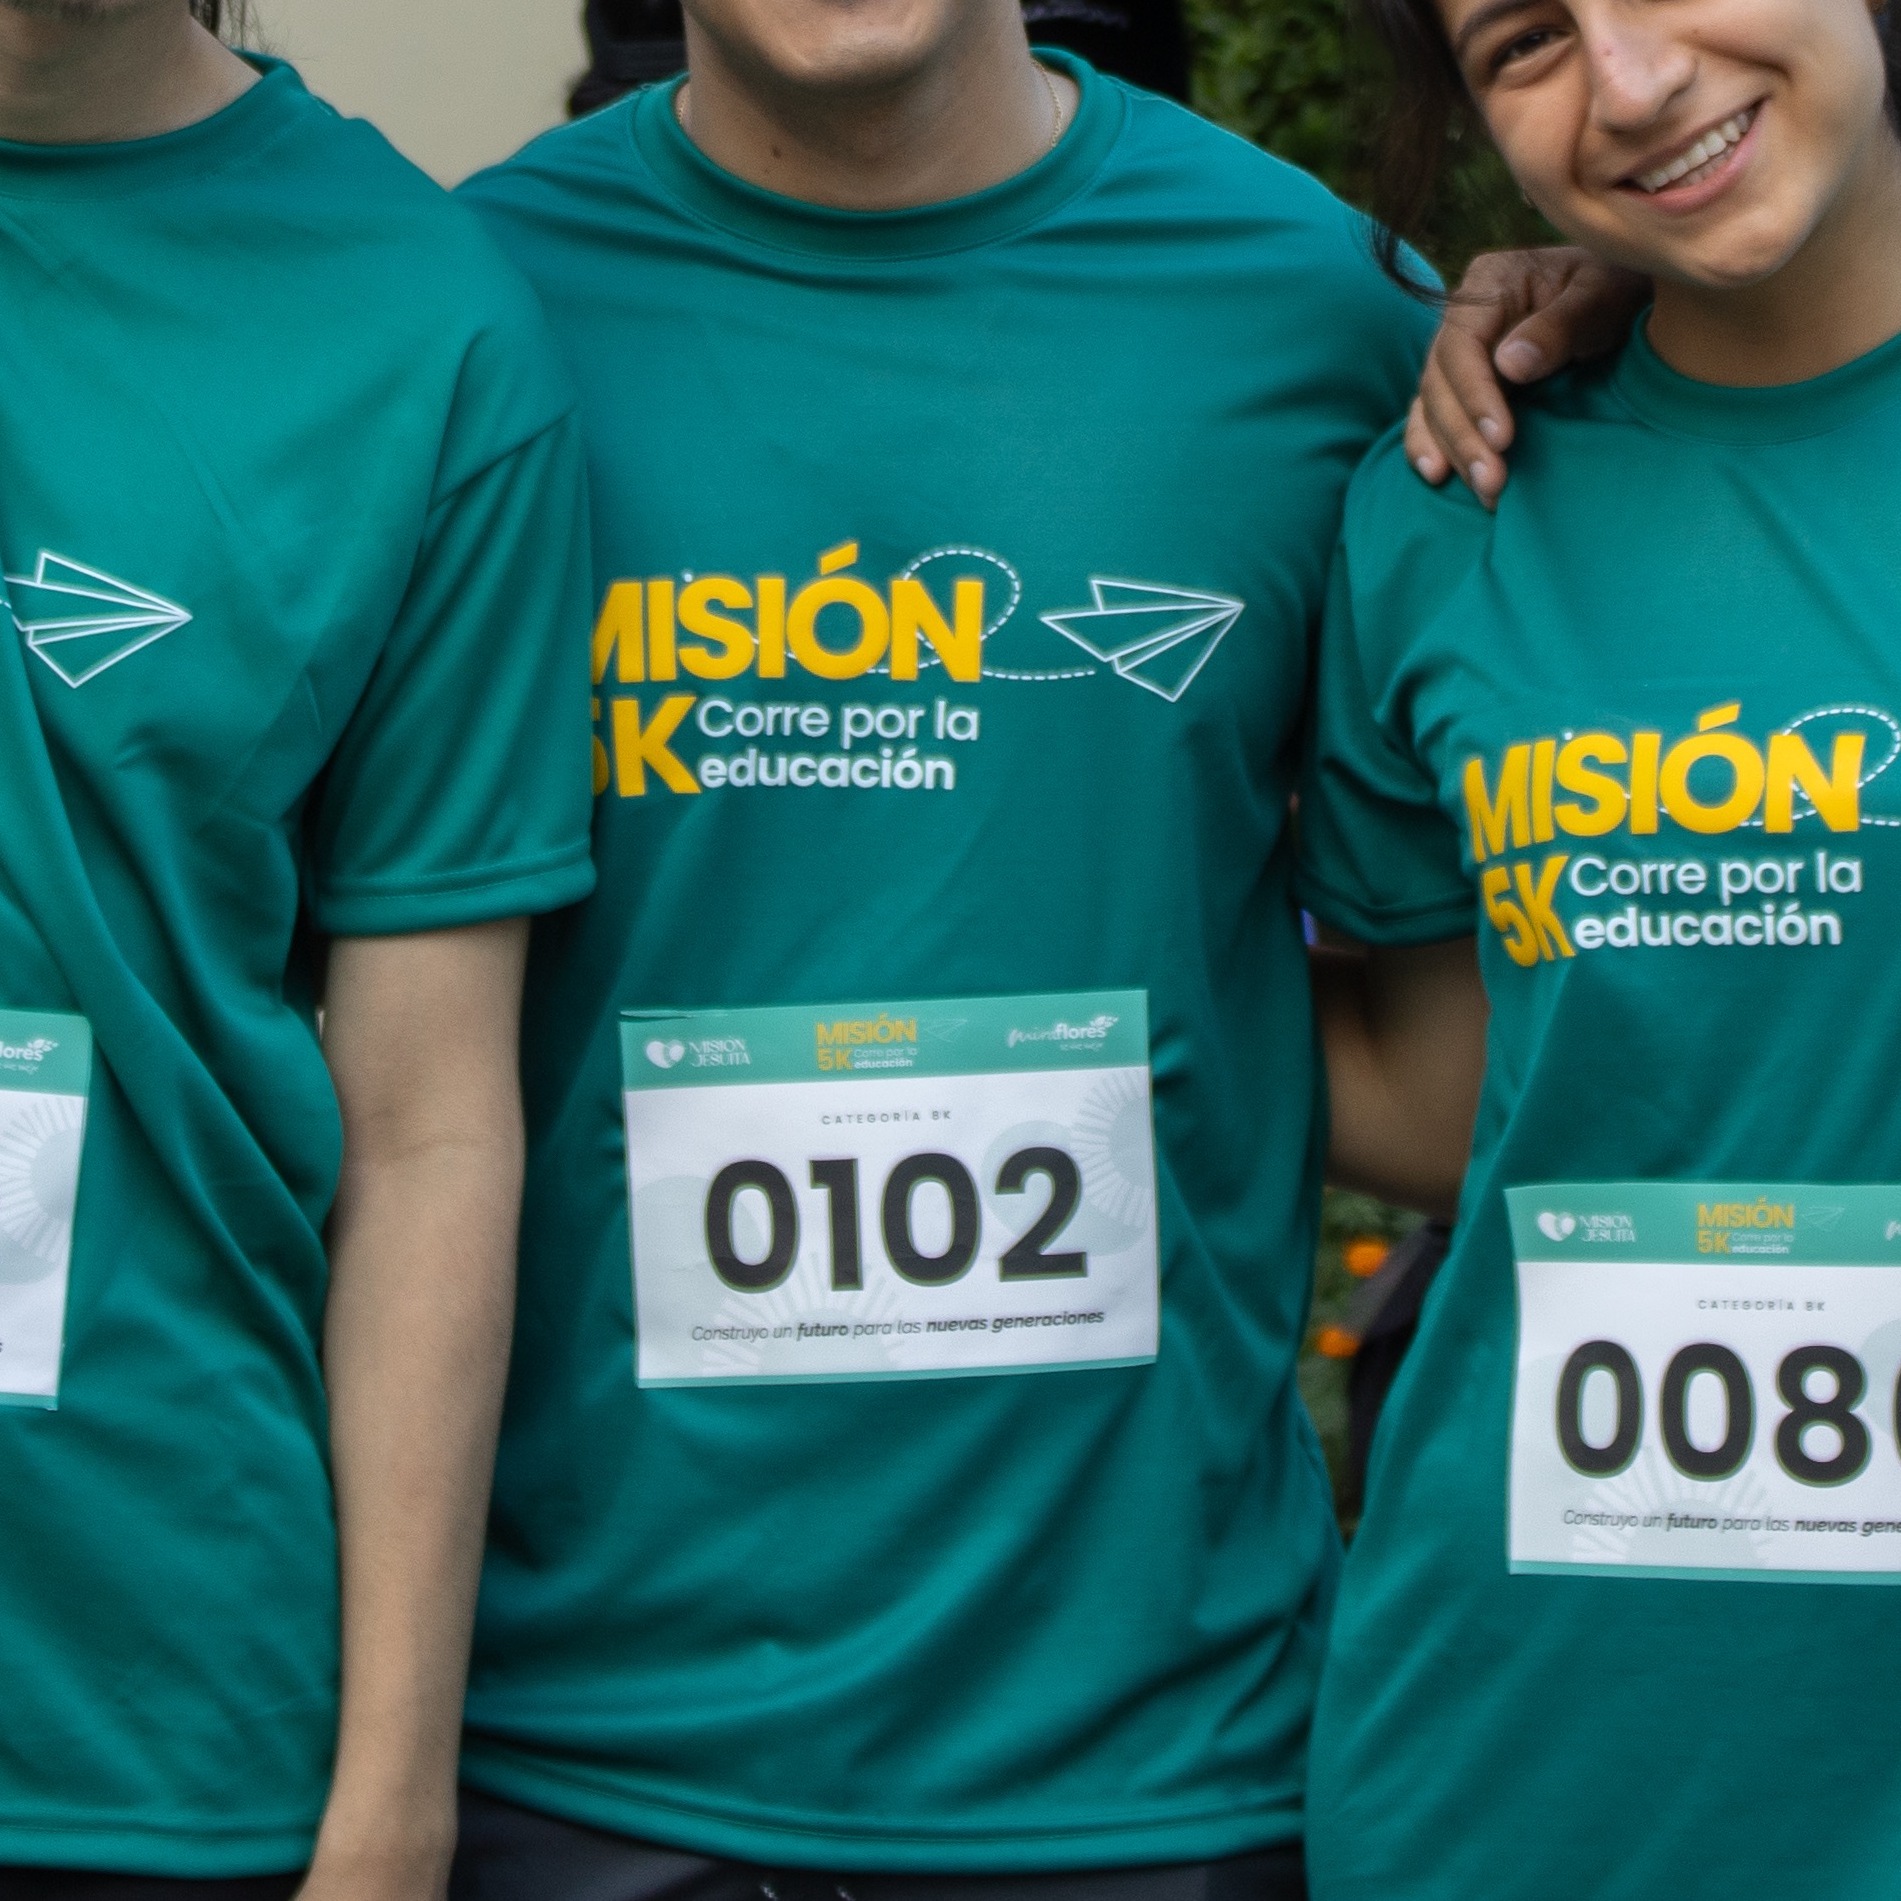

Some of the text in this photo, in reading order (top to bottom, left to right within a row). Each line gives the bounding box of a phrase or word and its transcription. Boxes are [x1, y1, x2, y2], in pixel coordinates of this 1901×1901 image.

[699, 698, 979, 749] Corre por la
[592, 694, 701, 797] K
[700, 748, 955, 790] educación
[1462, 702, 1866, 863] MISIÓN
[1569, 851, 1862, 905] Corre por la
[1480, 854, 1578, 968] 5K
[1573, 902, 1842, 951] educación
[815, 1012, 917, 1047] MISIÓN
[816, 1048, 853, 1071] 5K
[822, 1110, 920, 1125] CATEGORÍA
[704, 1146, 1088, 1294] 0102
[1697, 1195, 1794, 1229] MISIÓN
[1697, 1230, 1731, 1254] 5K
[1698, 1298, 1795, 1311] CATEGORÍA
[691, 1309, 1105, 1343] Construyo un futuro para las nuevas generaciones
[1564, 1509, 1639, 1530] Construyo
[1642, 1514, 1663, 1528] un
[1664, 1512, 1718, 1531] futuro
[1721, 1516, 1762, 1533] para
[1765, 1515, 1790, 1532] las
[1794, 1518, 1858, 1533] nuevas
